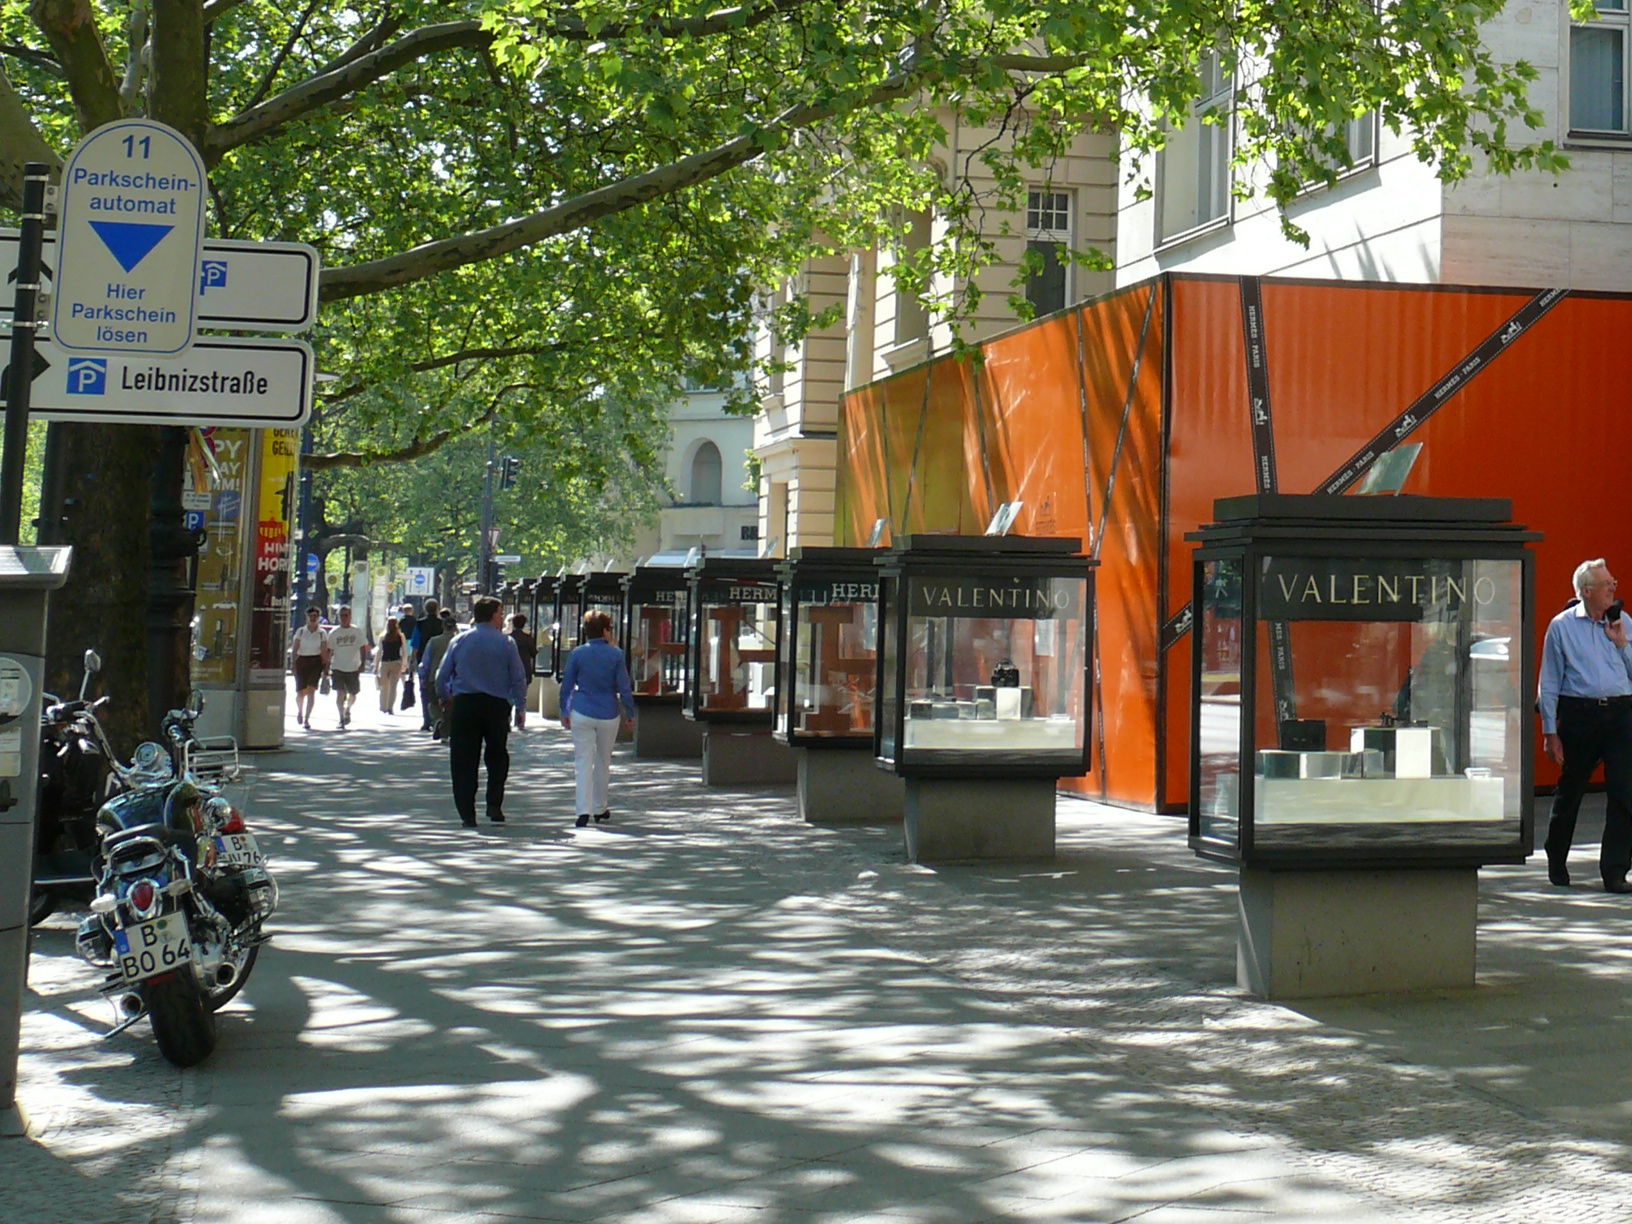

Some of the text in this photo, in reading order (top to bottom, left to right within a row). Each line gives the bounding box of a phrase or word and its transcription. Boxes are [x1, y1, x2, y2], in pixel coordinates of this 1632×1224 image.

[122, 135, 151, 159] 11
[74, 168, 197, 191] Parkschein-
[90, 195, 176, 214] automat
[107, 283, 146, 300] Hier
[72, 303, 176, 323] Parkschein
[96, 326, 148, 343] lösen
[1251, 344, 1261, 369] PARIS
[1461, 356, 1481, 376] PARIS
[121, 366, 268, 395] Leibnizstraße
[1355, 451, 1375, 470] PARIS
[923, 587, 1070, 609] VALENTINO
[1277, 574, 1496, 606] VALENTINO
[231, 836, 242, 851] B
[243, 850, 261, 864] 76
[141, 925, 157, 947] B
[123, 938, 190, 978] BO 64
